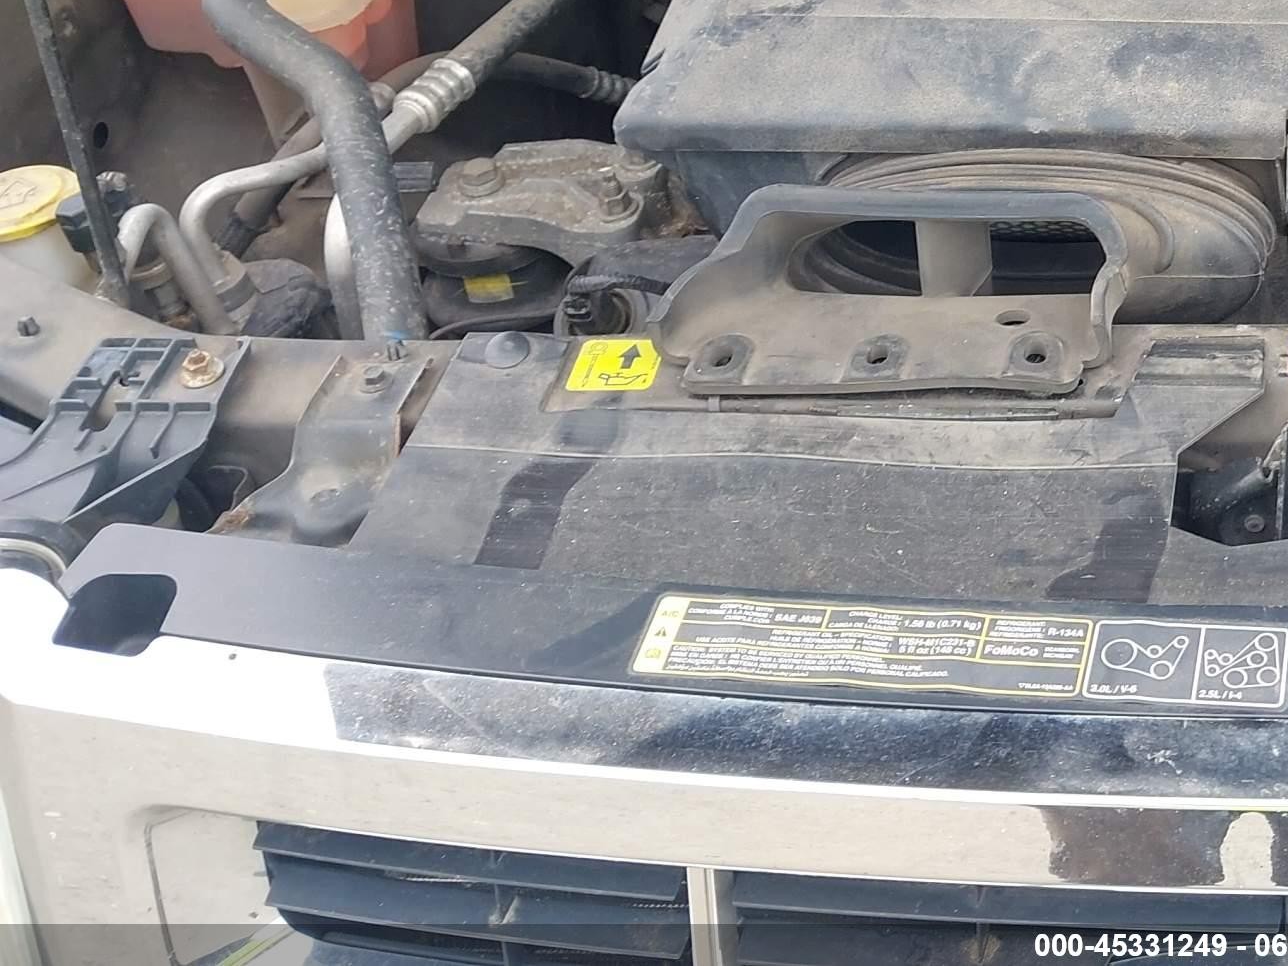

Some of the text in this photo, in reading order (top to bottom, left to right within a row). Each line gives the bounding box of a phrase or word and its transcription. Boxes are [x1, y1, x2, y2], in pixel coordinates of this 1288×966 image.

[774, 613, 797, 622] SAE
[926, 620, 936, 628] lb
[937, 620, 961, 629] (0.71
[963, 620, 981, 631] kg)
[1047, 627, 1084, 637] R-134A
[953, 647, 972, 656] cc)
[984, 644, 1039, 656] FoMoCo
[1090, 684, 1113, 693] 3.0L
[1198, 690, 1221, 699] 2.5L
